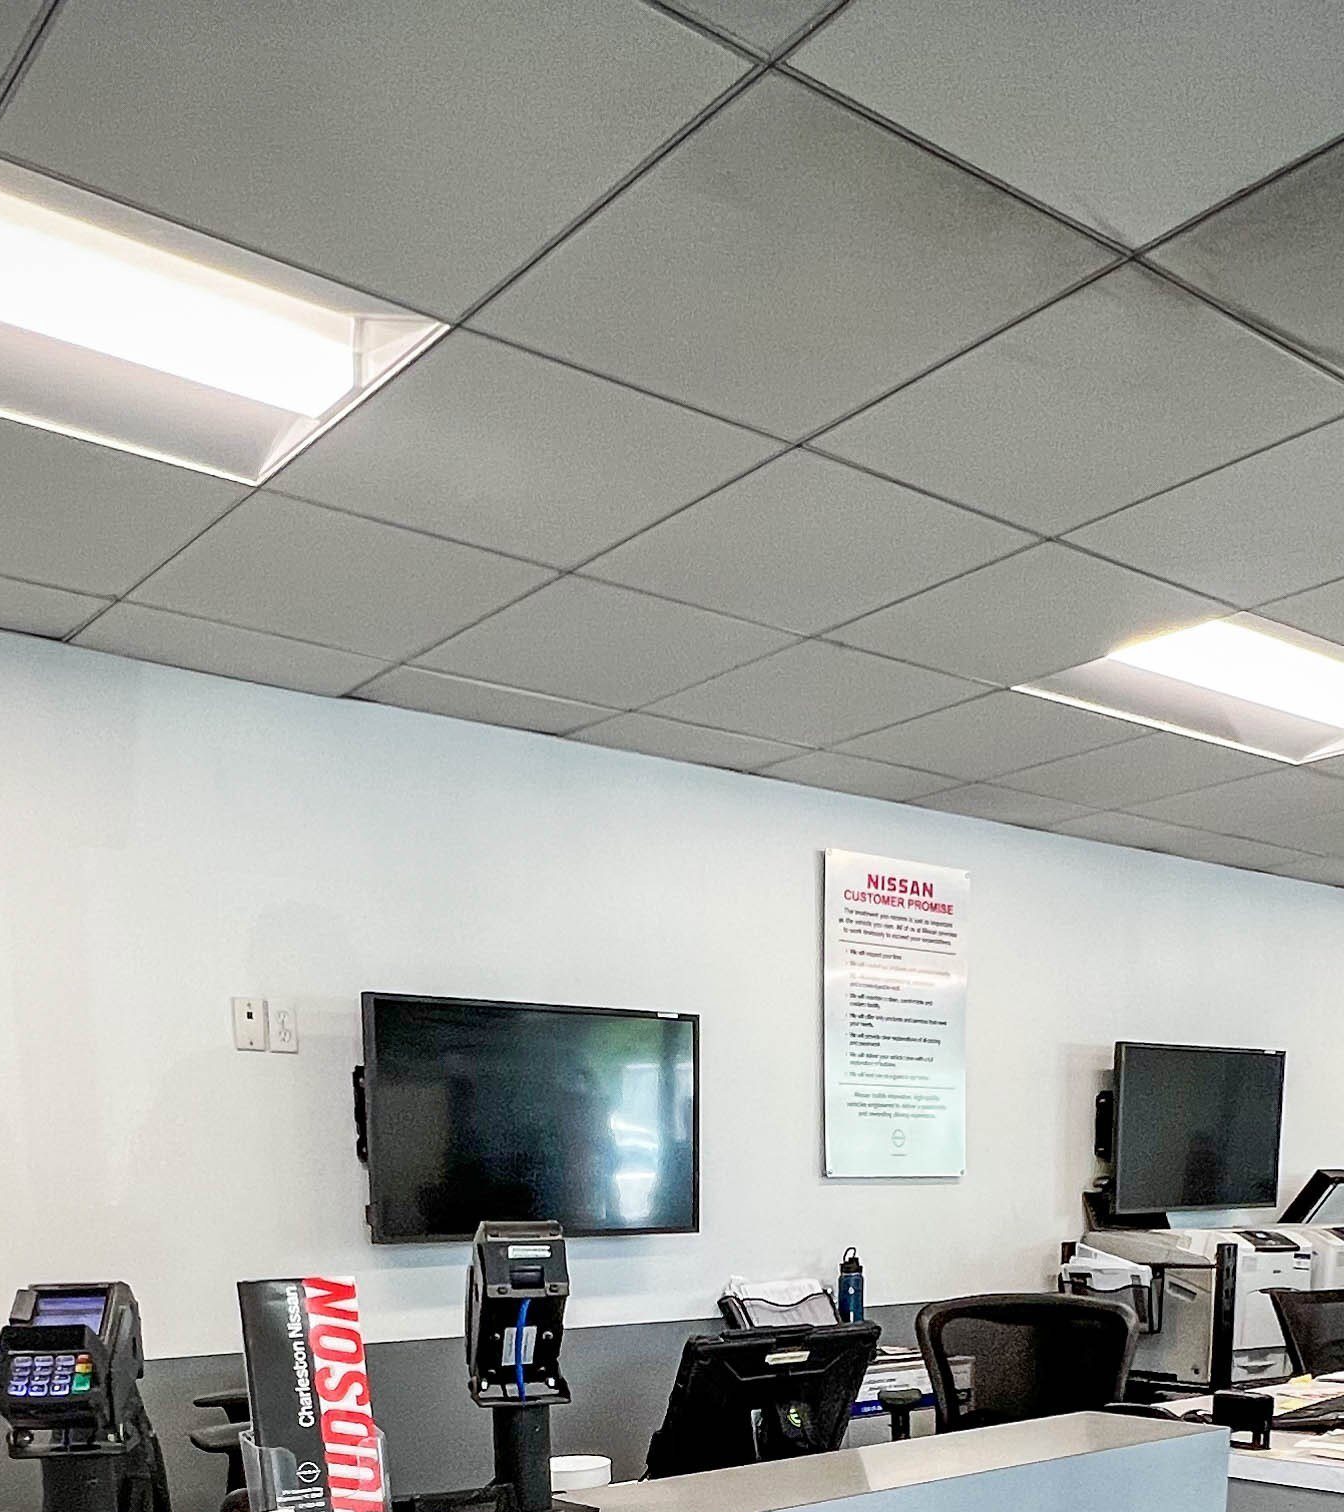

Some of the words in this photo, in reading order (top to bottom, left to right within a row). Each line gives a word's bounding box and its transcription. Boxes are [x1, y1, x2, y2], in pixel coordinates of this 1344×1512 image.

[843, 889, 906, 909] CUSTOMER
[907, 898, 955, 915] PROMISE
[866, 873, 934, 898] NISSAN
[285, 1285, 304, 1339] Nissan
[292, 1340, 315, 1428] Charleston
